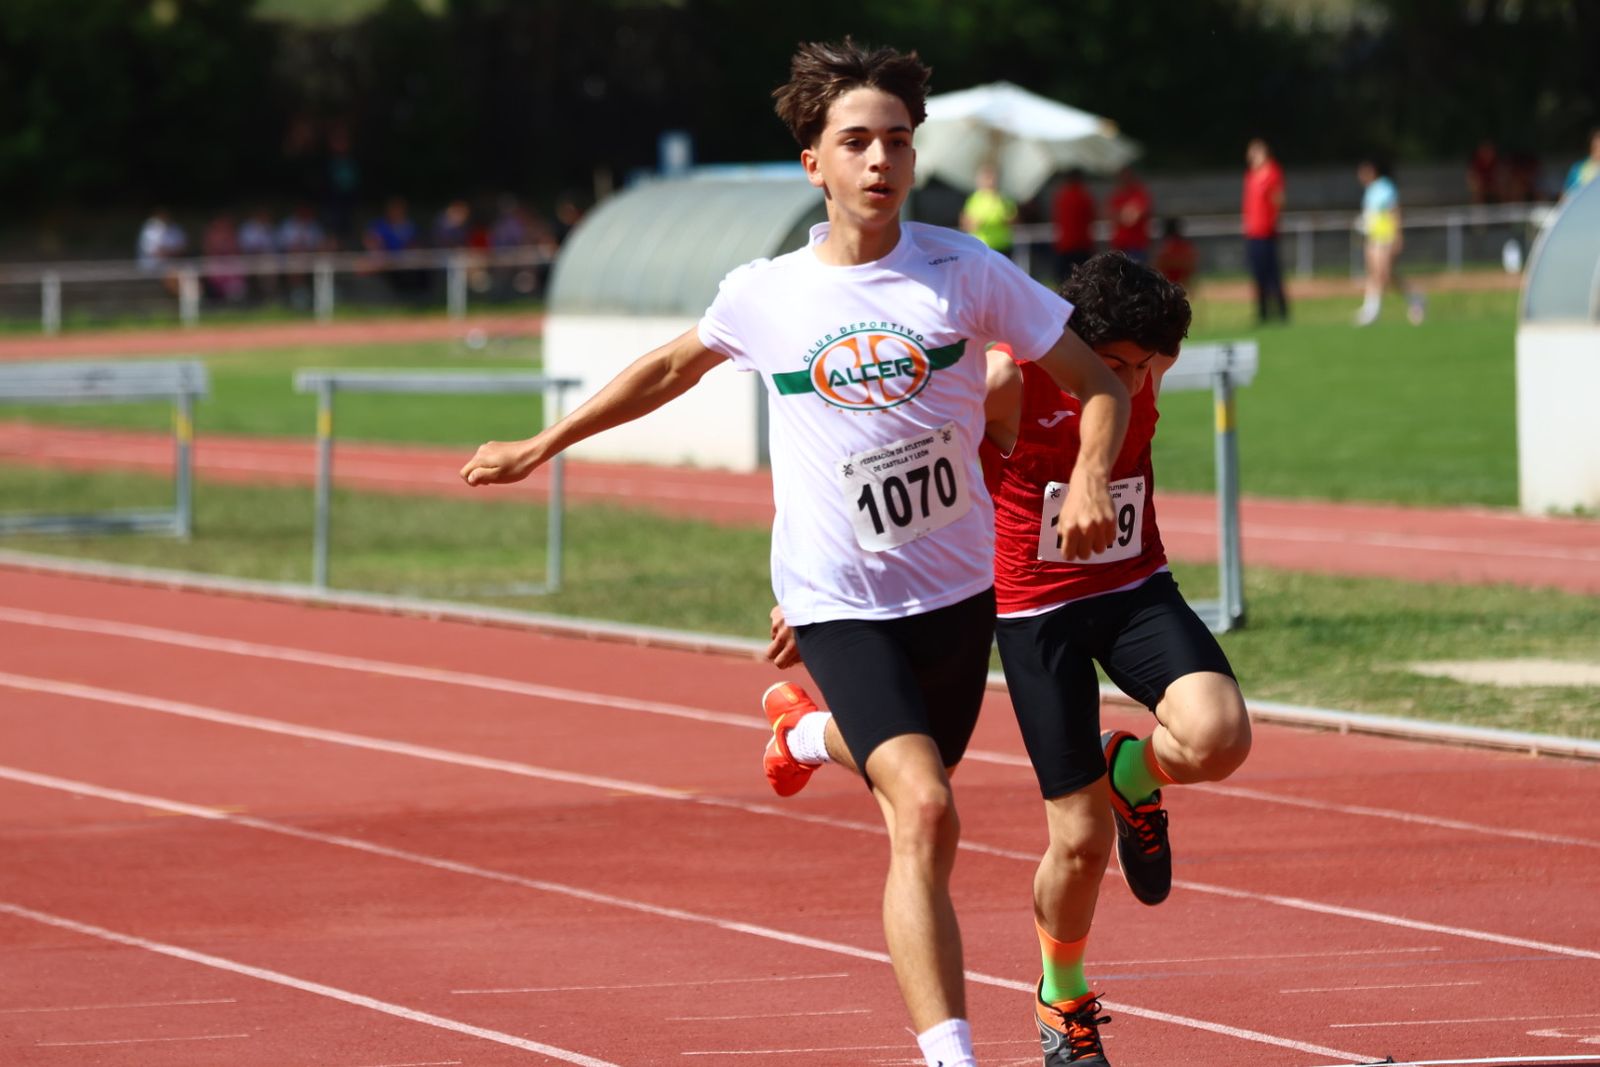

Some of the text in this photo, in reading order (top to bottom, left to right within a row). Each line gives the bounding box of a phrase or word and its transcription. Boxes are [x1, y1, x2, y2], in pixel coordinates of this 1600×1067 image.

[802, 321, 924, 363] CLUB DEPORTIVO
[828, 357, 918, 388] ALCER
[860, 436, 935, 465] FEDERACIÓN DE ATLETISMO
[873, 464, 882, 472] DE
[882, 456, 909, 470] CASTILLA
[914, 449, 930, 460] LEÓN
[857, 456, 957, 535] 1070
